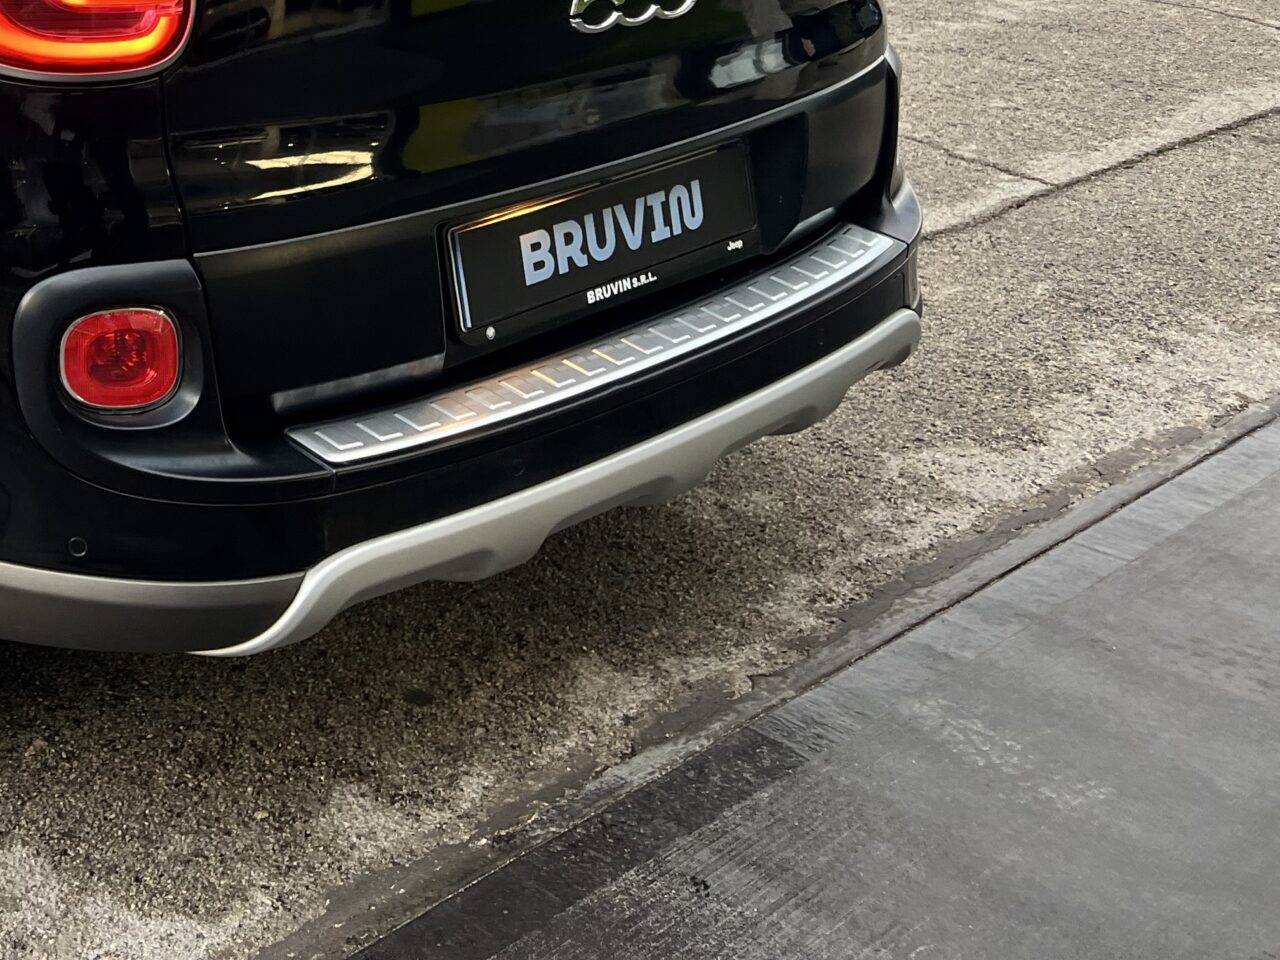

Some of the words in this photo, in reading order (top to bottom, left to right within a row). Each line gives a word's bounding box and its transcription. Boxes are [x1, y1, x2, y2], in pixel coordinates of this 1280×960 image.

[519, 179, 704, 286] BRUVIN
[727, 240, 743, 250] Jeep
[586, 277, 632, 304] BRUVIN
